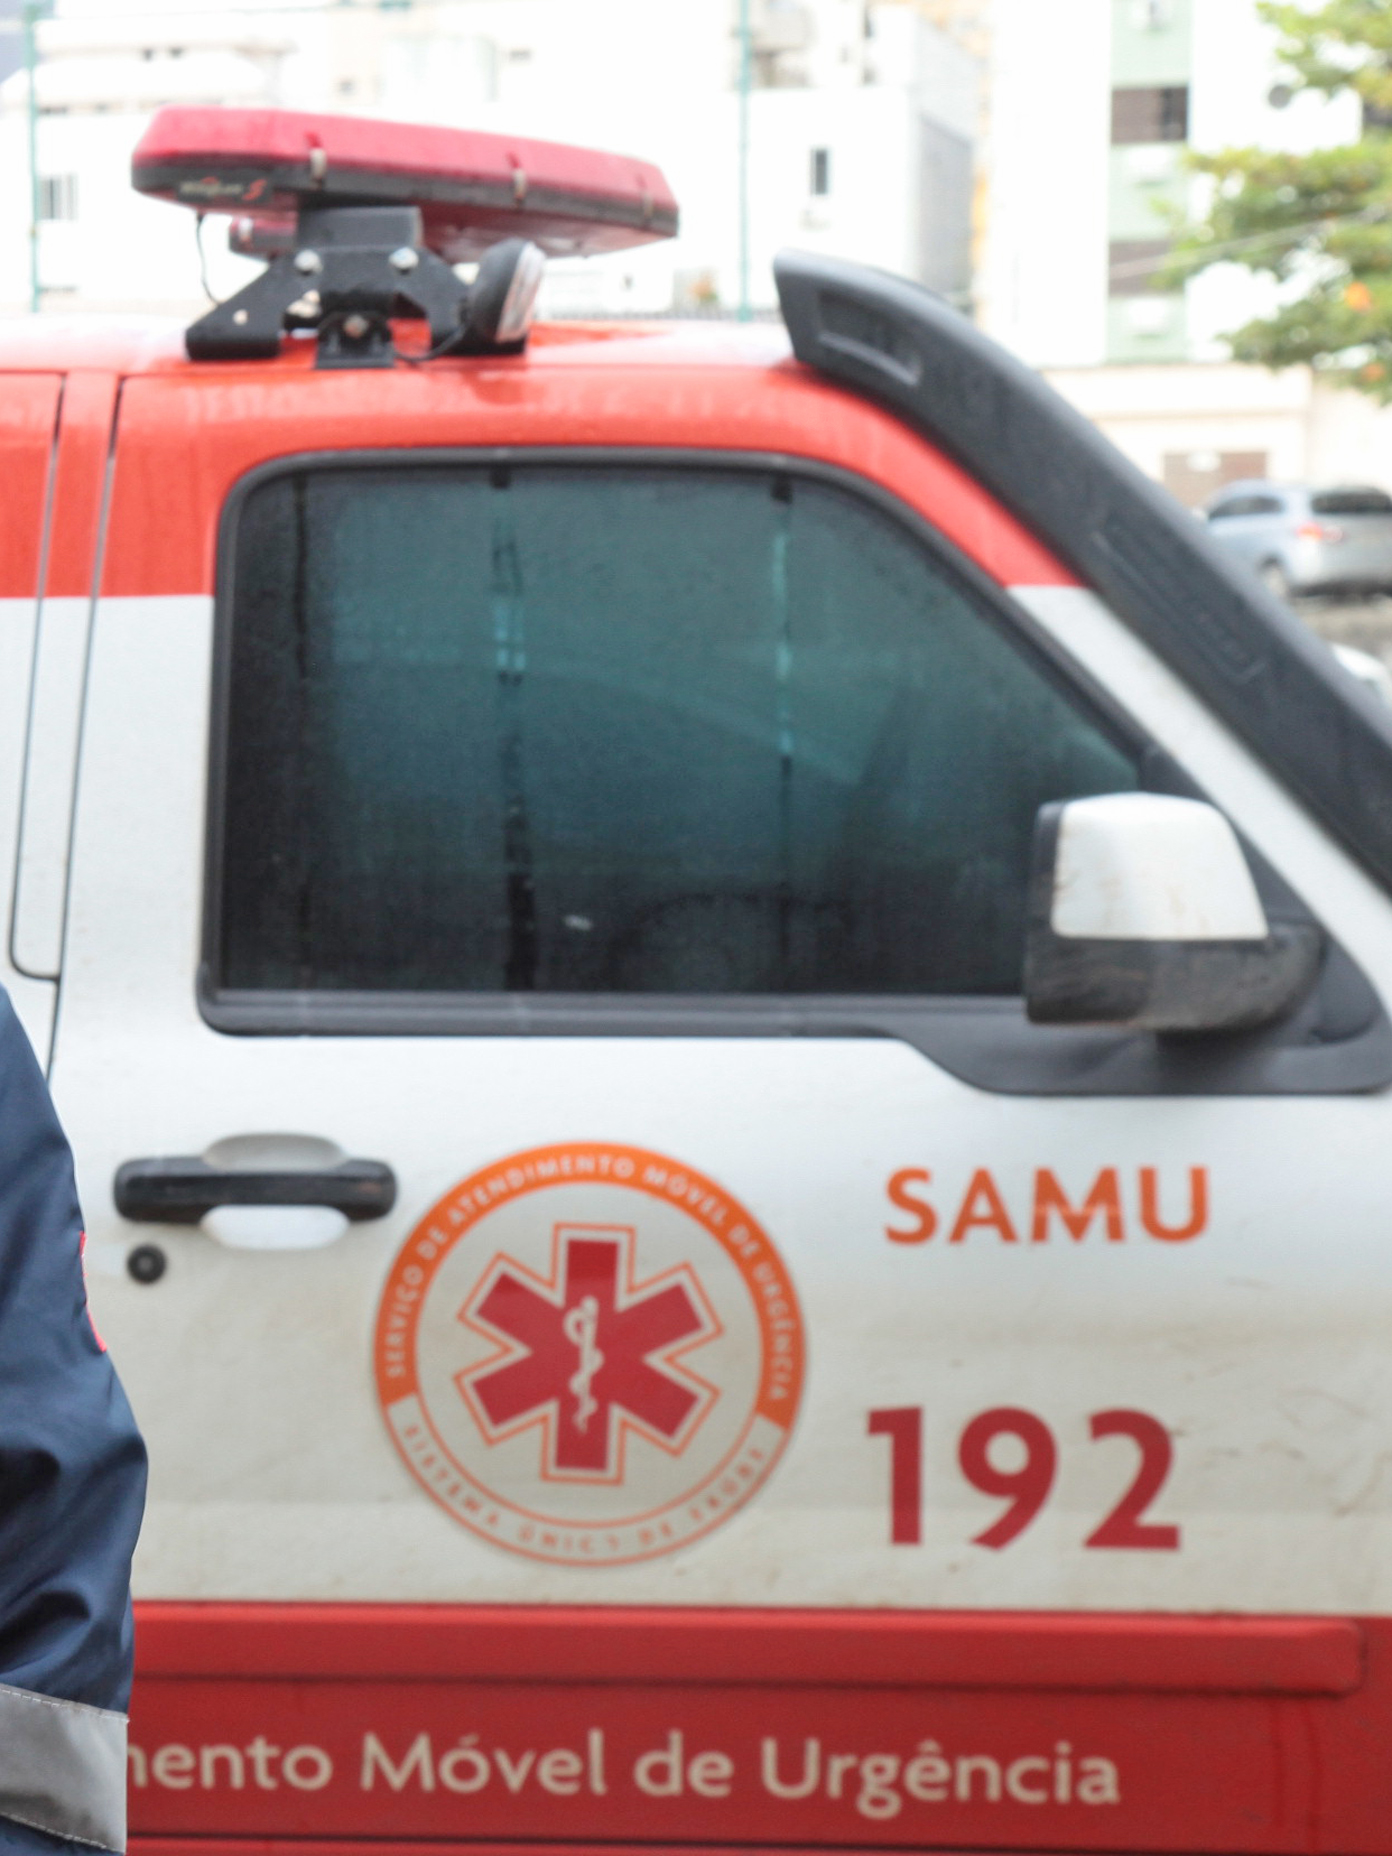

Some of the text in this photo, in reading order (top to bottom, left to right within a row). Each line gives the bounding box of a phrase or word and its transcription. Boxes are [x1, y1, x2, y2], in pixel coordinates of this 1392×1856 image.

[884, 1164, 1210, 1246] SAMU
[384, 1263, 425, 1379] SERVIÇO
[416, 1225, 450, 1260] DE
[447, 1154, 636, 1226] ATENDIMENTO
[642, 1162, 728, 1226] MÓVEL
[728, 1223, 761, 1259] DE
[866, 1405, 1182, 1552] 192
[360, 1727, 607, 1796] Móvel
[633, 1728, 735, 1798] de
[760, 1736, 1121, 1820] Urgência
